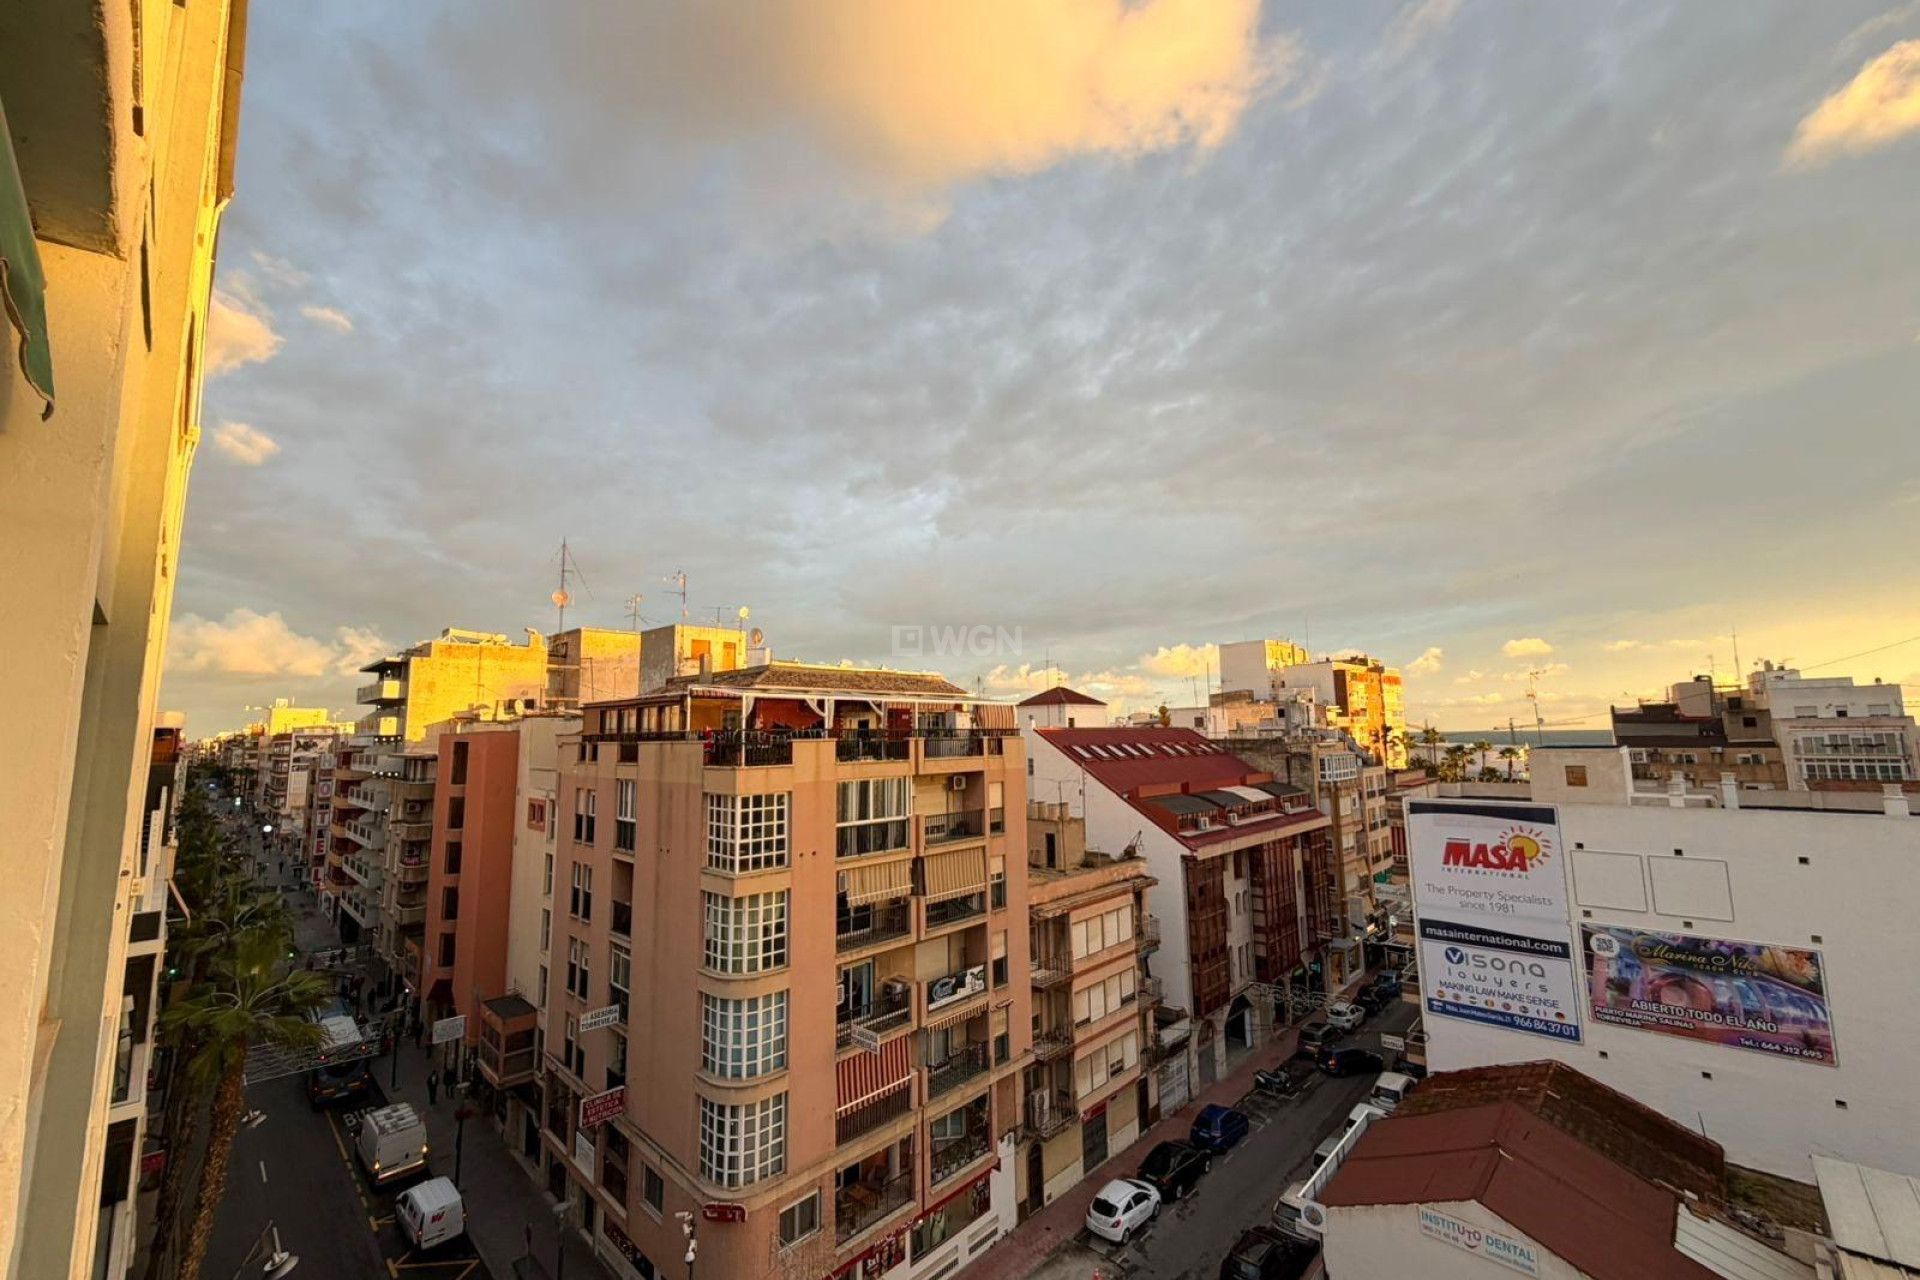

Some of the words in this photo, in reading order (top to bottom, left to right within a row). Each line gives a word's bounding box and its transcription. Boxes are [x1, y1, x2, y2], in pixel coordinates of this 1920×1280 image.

[313, 755, 332, 882] HOTEL
[1442, 840, 1528, 872] MASA
[1441, 867, 1530, 880] INTERNATIONAL
[1425, 883, 1446, 895] The
[1448, 885, 1494, 900] Property
[1497, 890, 1553, 906] Specialists
[1459, 899, 1486, 911] since
[1489, 902, 1515, 914] 1981
[1425, 926, 1562, 953] masainternational.com
[1640, 944, 1707, 963] Marina
[1439, 980, 1474, 993] MAKING
[1475, 986, 1496, 997] LAW
[1497, 990, 1525, 1003] MAKE
[1526, 995, 1560, 1009] SENSE
[1595, 1006, 1624, 1017] PUERTO
[1625, 1011, 1657, 1023] MARINA
[1658, 1017, 1695, 1029] SALINAS
[1596, 1013, 1641, 1026] TORREVIEJA
[1631, 1000, 1684, 1017] ABIERTO
[1687, 1009, 1722, 1023] TODO
[1727, 1015, 1743, 1027] EL
[1746, 1018, 1778, 1033] AÑO
[1562, 1025, 1577, 1037] 01
[1421, 1210, 1482, 1242] INSTITUTO
[1485, 1234, 1536, 1263] DENTAL
